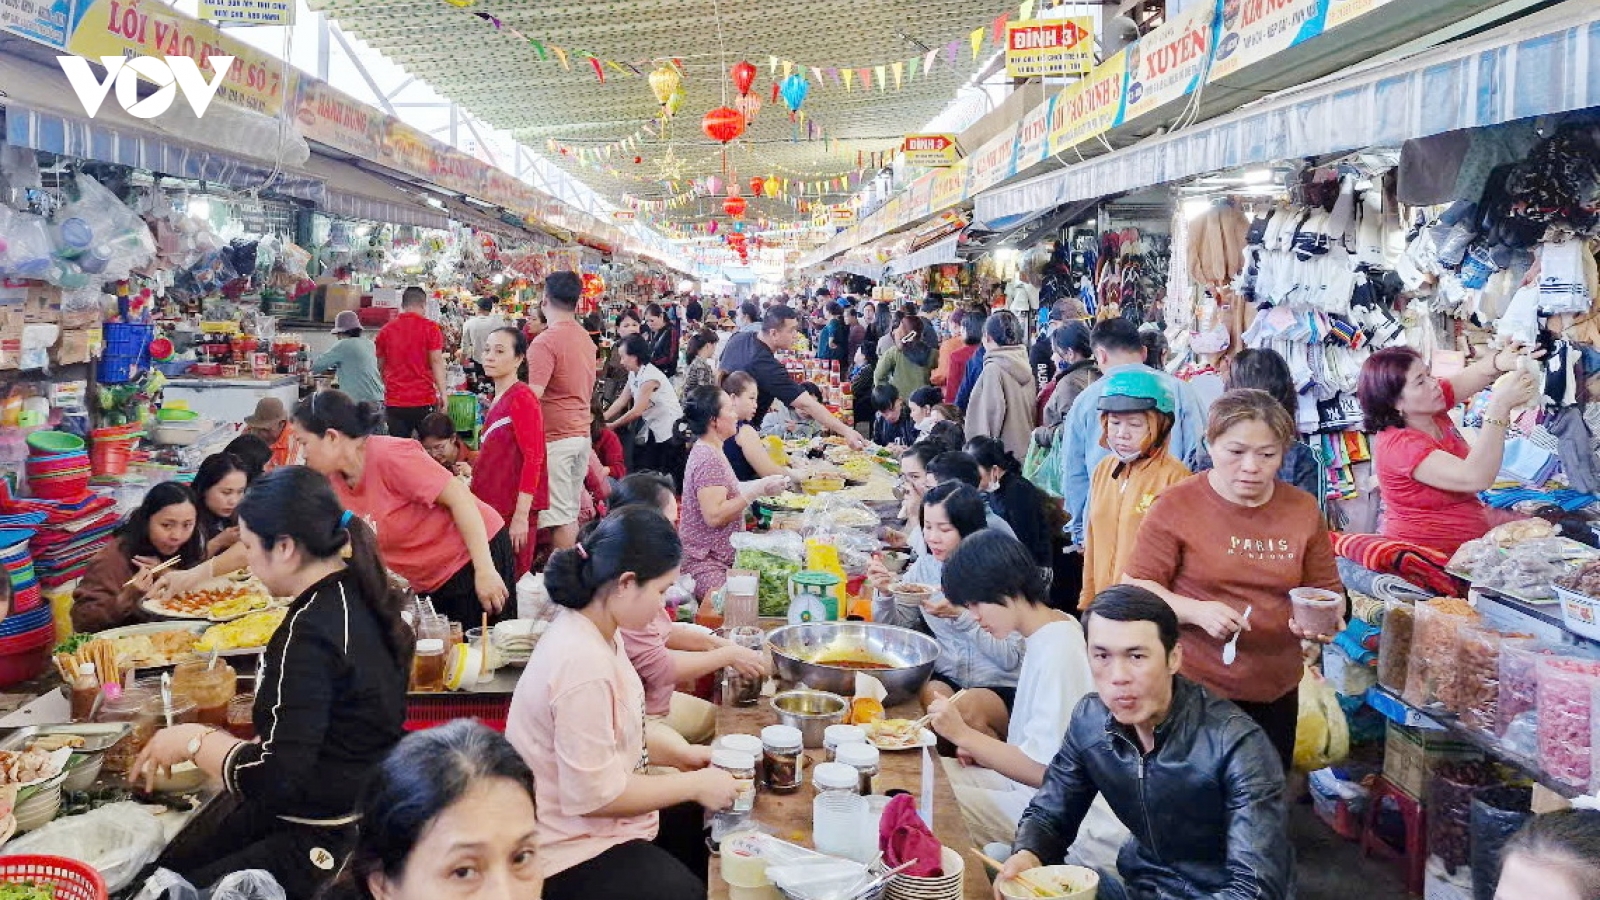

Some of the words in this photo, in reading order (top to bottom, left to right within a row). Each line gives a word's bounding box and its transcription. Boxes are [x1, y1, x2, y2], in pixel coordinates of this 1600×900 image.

[1014, 28, 1057, 49] ĐÌNH
[1062, 29, 1072, 46] 3
[1146, 19, 1207, 80] XUYẾN
[199, 41, 245, 85] ĐH
[937, 138, 943, 149] 3
[1230, 536, 1288, 551] PARIS
